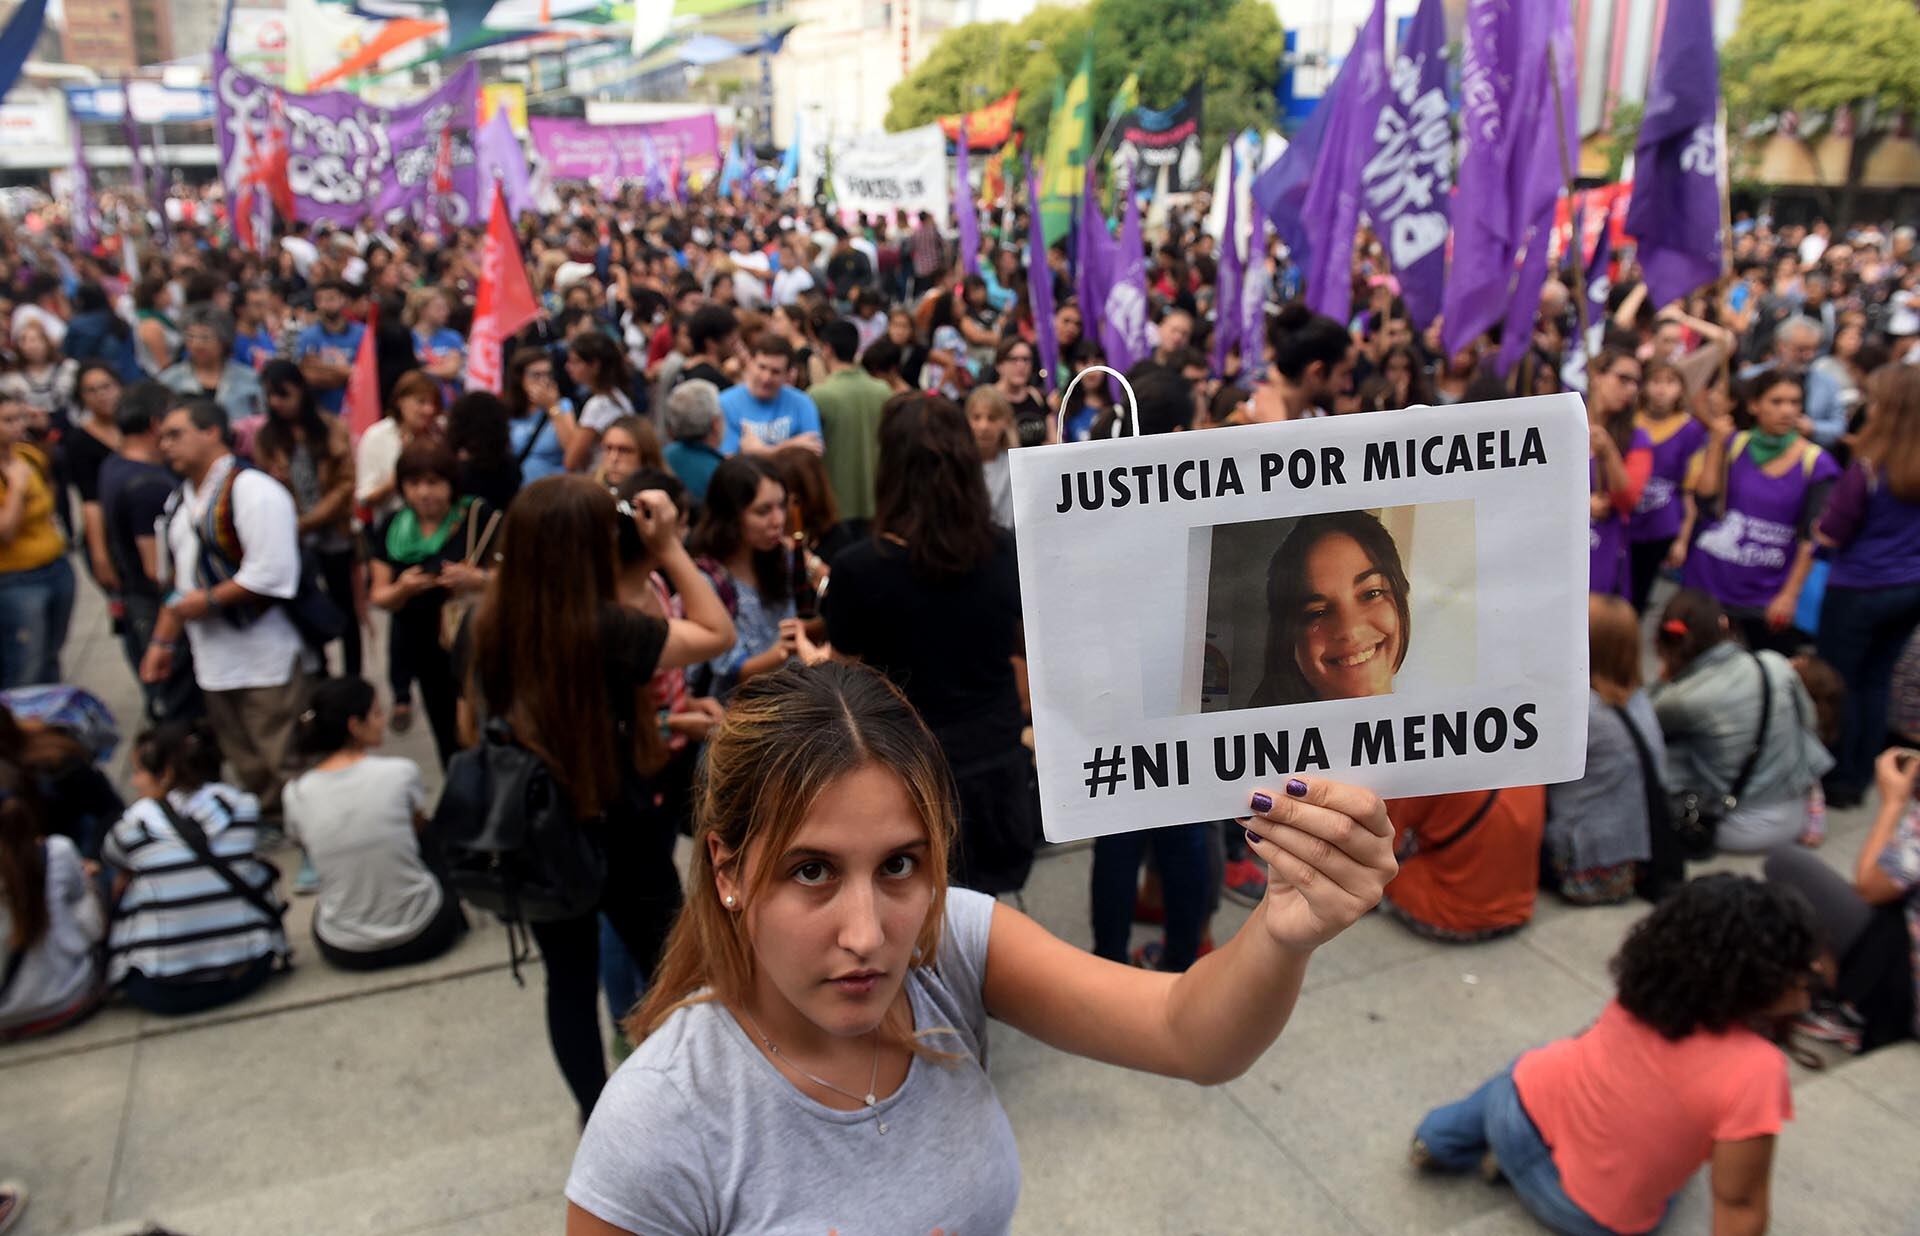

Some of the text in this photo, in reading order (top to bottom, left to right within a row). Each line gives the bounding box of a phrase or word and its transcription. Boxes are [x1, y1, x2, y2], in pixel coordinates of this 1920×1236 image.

[1057, 427, 1547, 513] JUSTICIA POR MICAELA
[1084, 703, 1538, 798] #NI UNA MENOS
